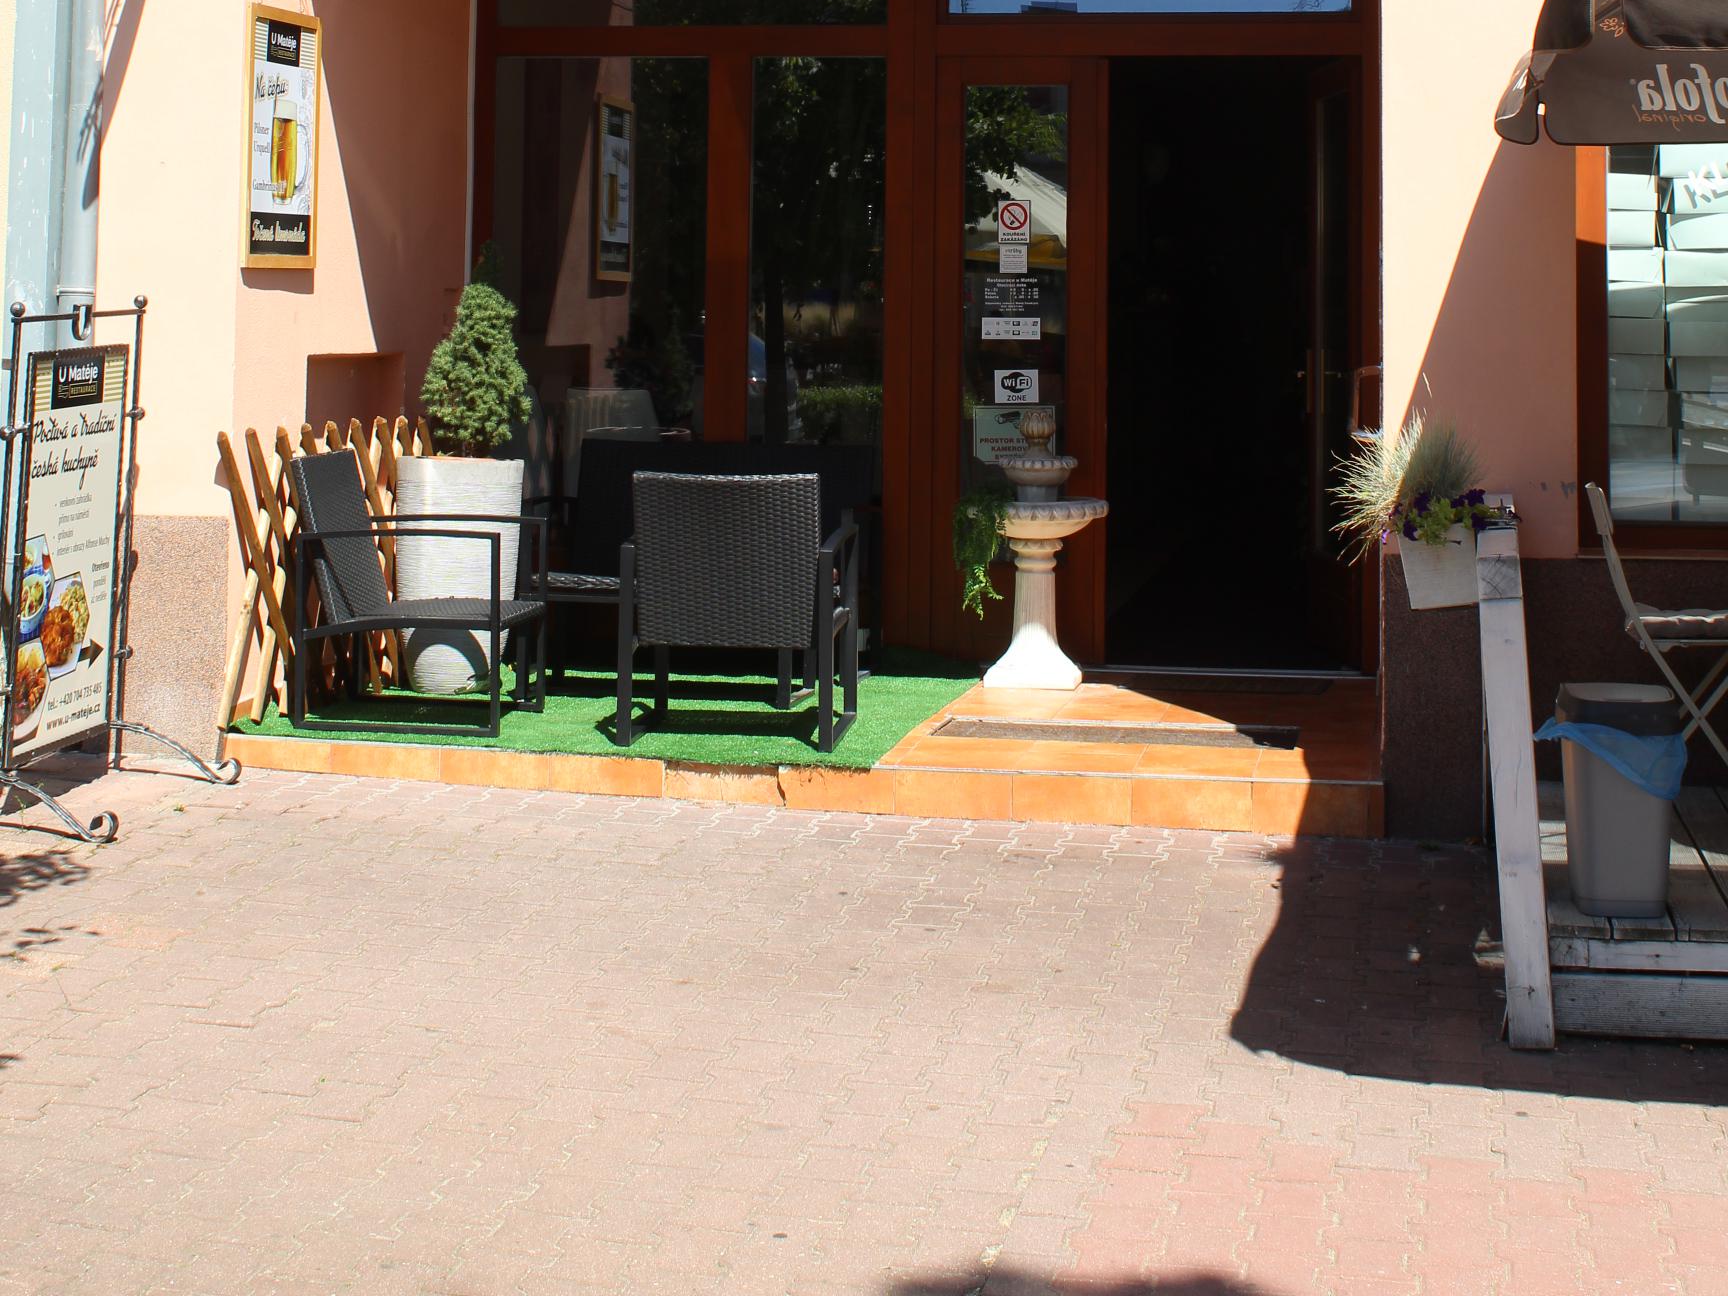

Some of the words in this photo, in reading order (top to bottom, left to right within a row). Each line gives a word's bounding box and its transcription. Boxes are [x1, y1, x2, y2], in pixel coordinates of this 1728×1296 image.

[271, 32, 277, 45] U
[59, 365, 67, 383] U
[71, 423, 78, 438] a
[31, 450, 59, 479] česká
[62, 446, 99, 490] kuchyně
